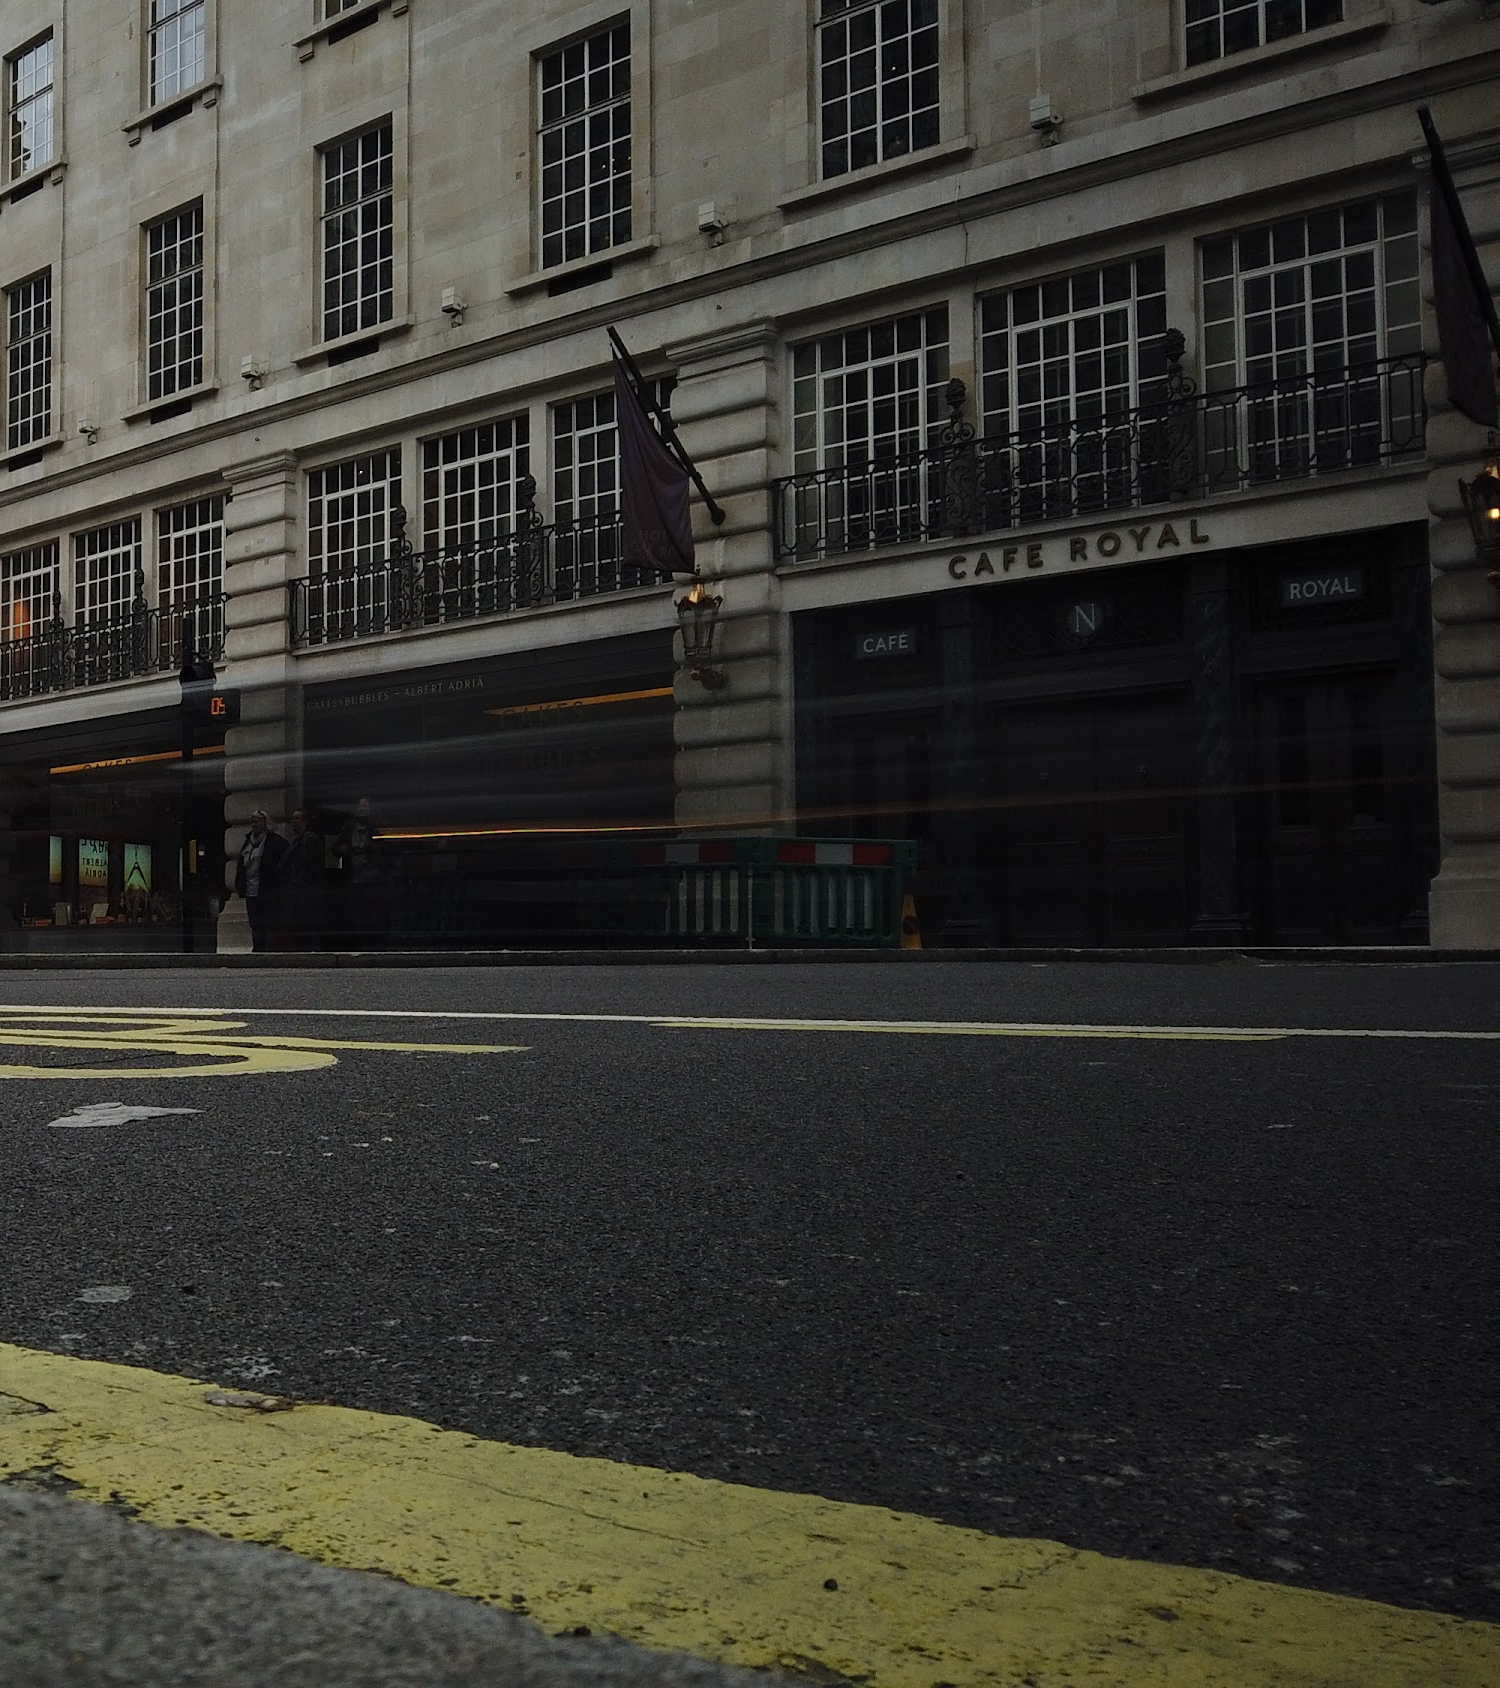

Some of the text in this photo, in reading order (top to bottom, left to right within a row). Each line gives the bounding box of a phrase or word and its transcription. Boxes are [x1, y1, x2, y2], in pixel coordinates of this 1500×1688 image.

[948, 518, 1209, 579] CAFE ROYAL
[1290, 576, 1357, 600] ROYAL
[1074, 603, 1095, 632] N
[863, 631, 909, 653] CAFÉ
[404, 682, 443, 696] ALBERT
